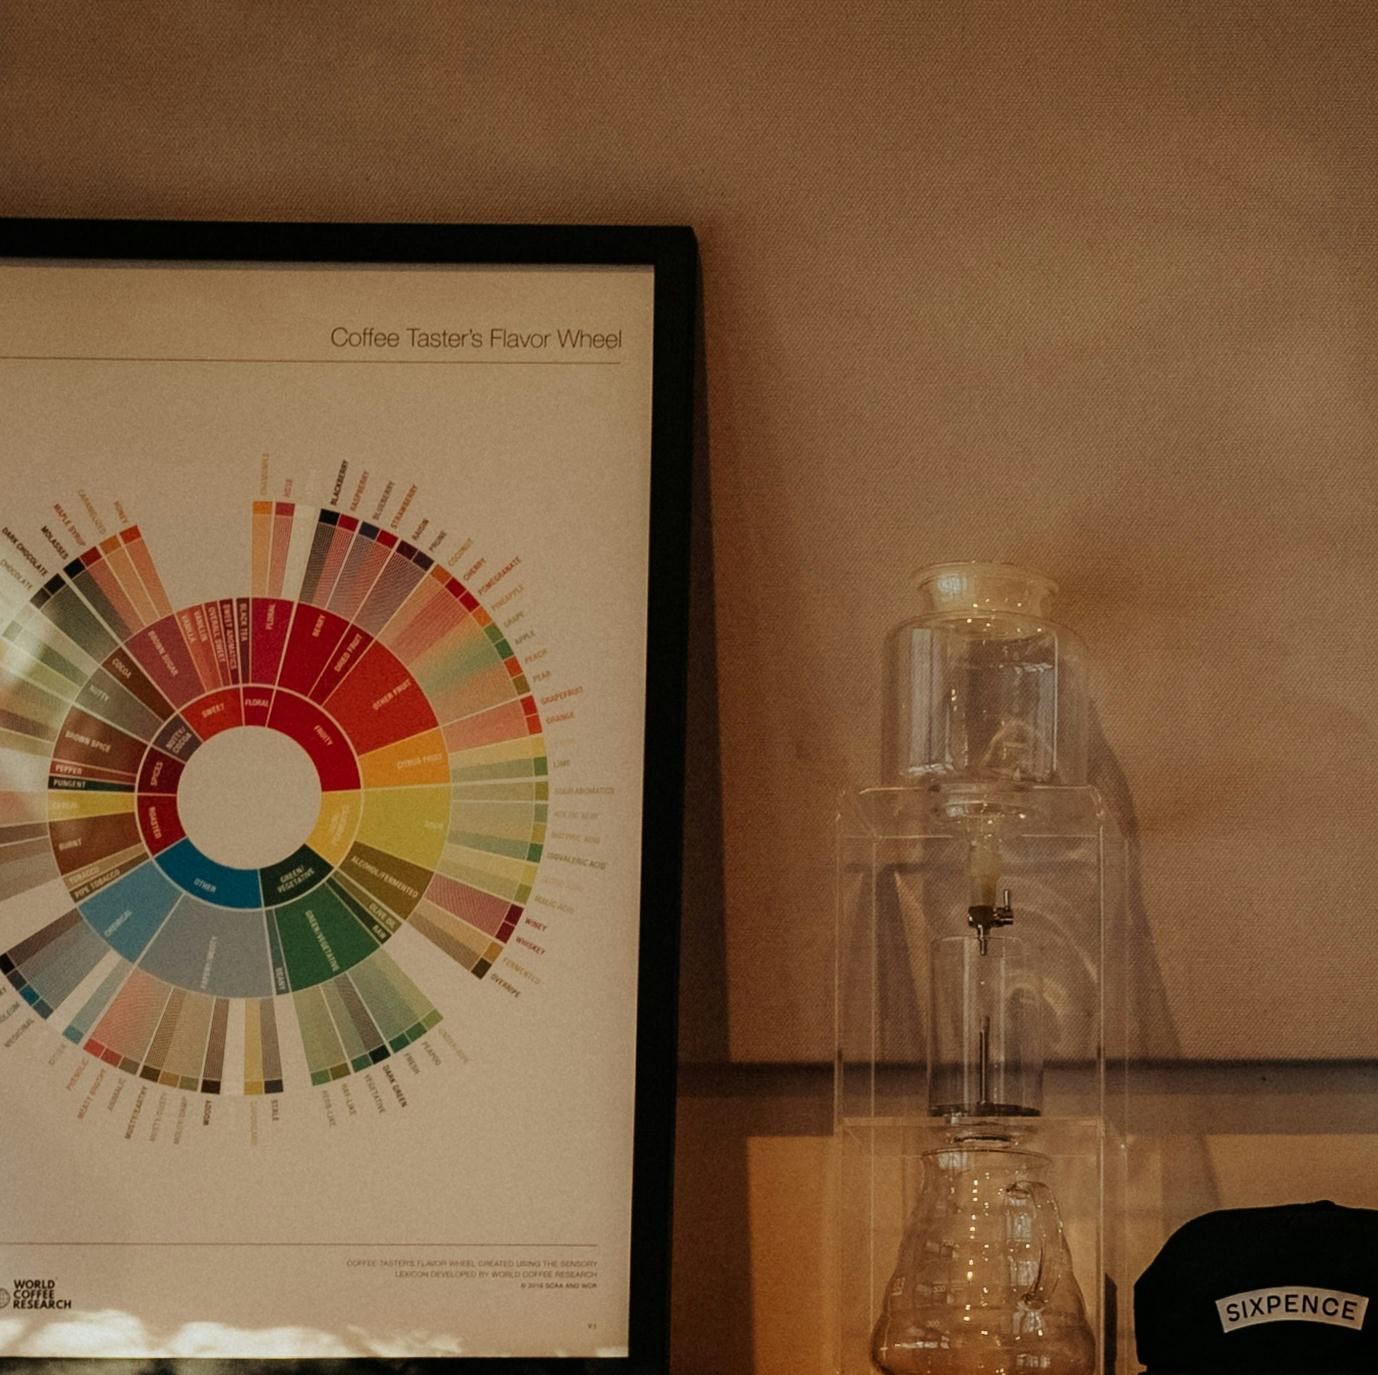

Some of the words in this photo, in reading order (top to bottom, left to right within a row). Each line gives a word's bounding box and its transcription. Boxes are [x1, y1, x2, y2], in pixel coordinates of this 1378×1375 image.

[331, 328, 399, 349] Coffee
[406, 328, 483, 349] Taster's
[489, 328, 552, 349] Flavor
[557, 329, 622, 350] Wheel
[330, 459, 349, 506] BLACKBERRY
[390, 483, 418, 530] STRAWBERRY
[2, 527, 18, 545] DARK
[16, 542, 49, 577] CHOCOLATE
[41, 525, 69, 560] MOLASSES
[478, 556, 522, 595] POMEGRANATE
[111, 658, 132, 679] COCOA
[245, 698, 270, 708] FLORAL
[53, 778, 86, 789] PUNGENT
[193, 877, 217, 893] OTHER
[351, 855, 420, 899] ALCOHOL/FERMENTED
[524, 917, 548, 933] WINEY
[13, 1280, 55, 1290] WORLD
[13, 1290, 55, 1299] COFFEE
[13, 1300, 72, 1309] RESEARCH
[1226, 1294, 1359, 1322] SIXPENCE
